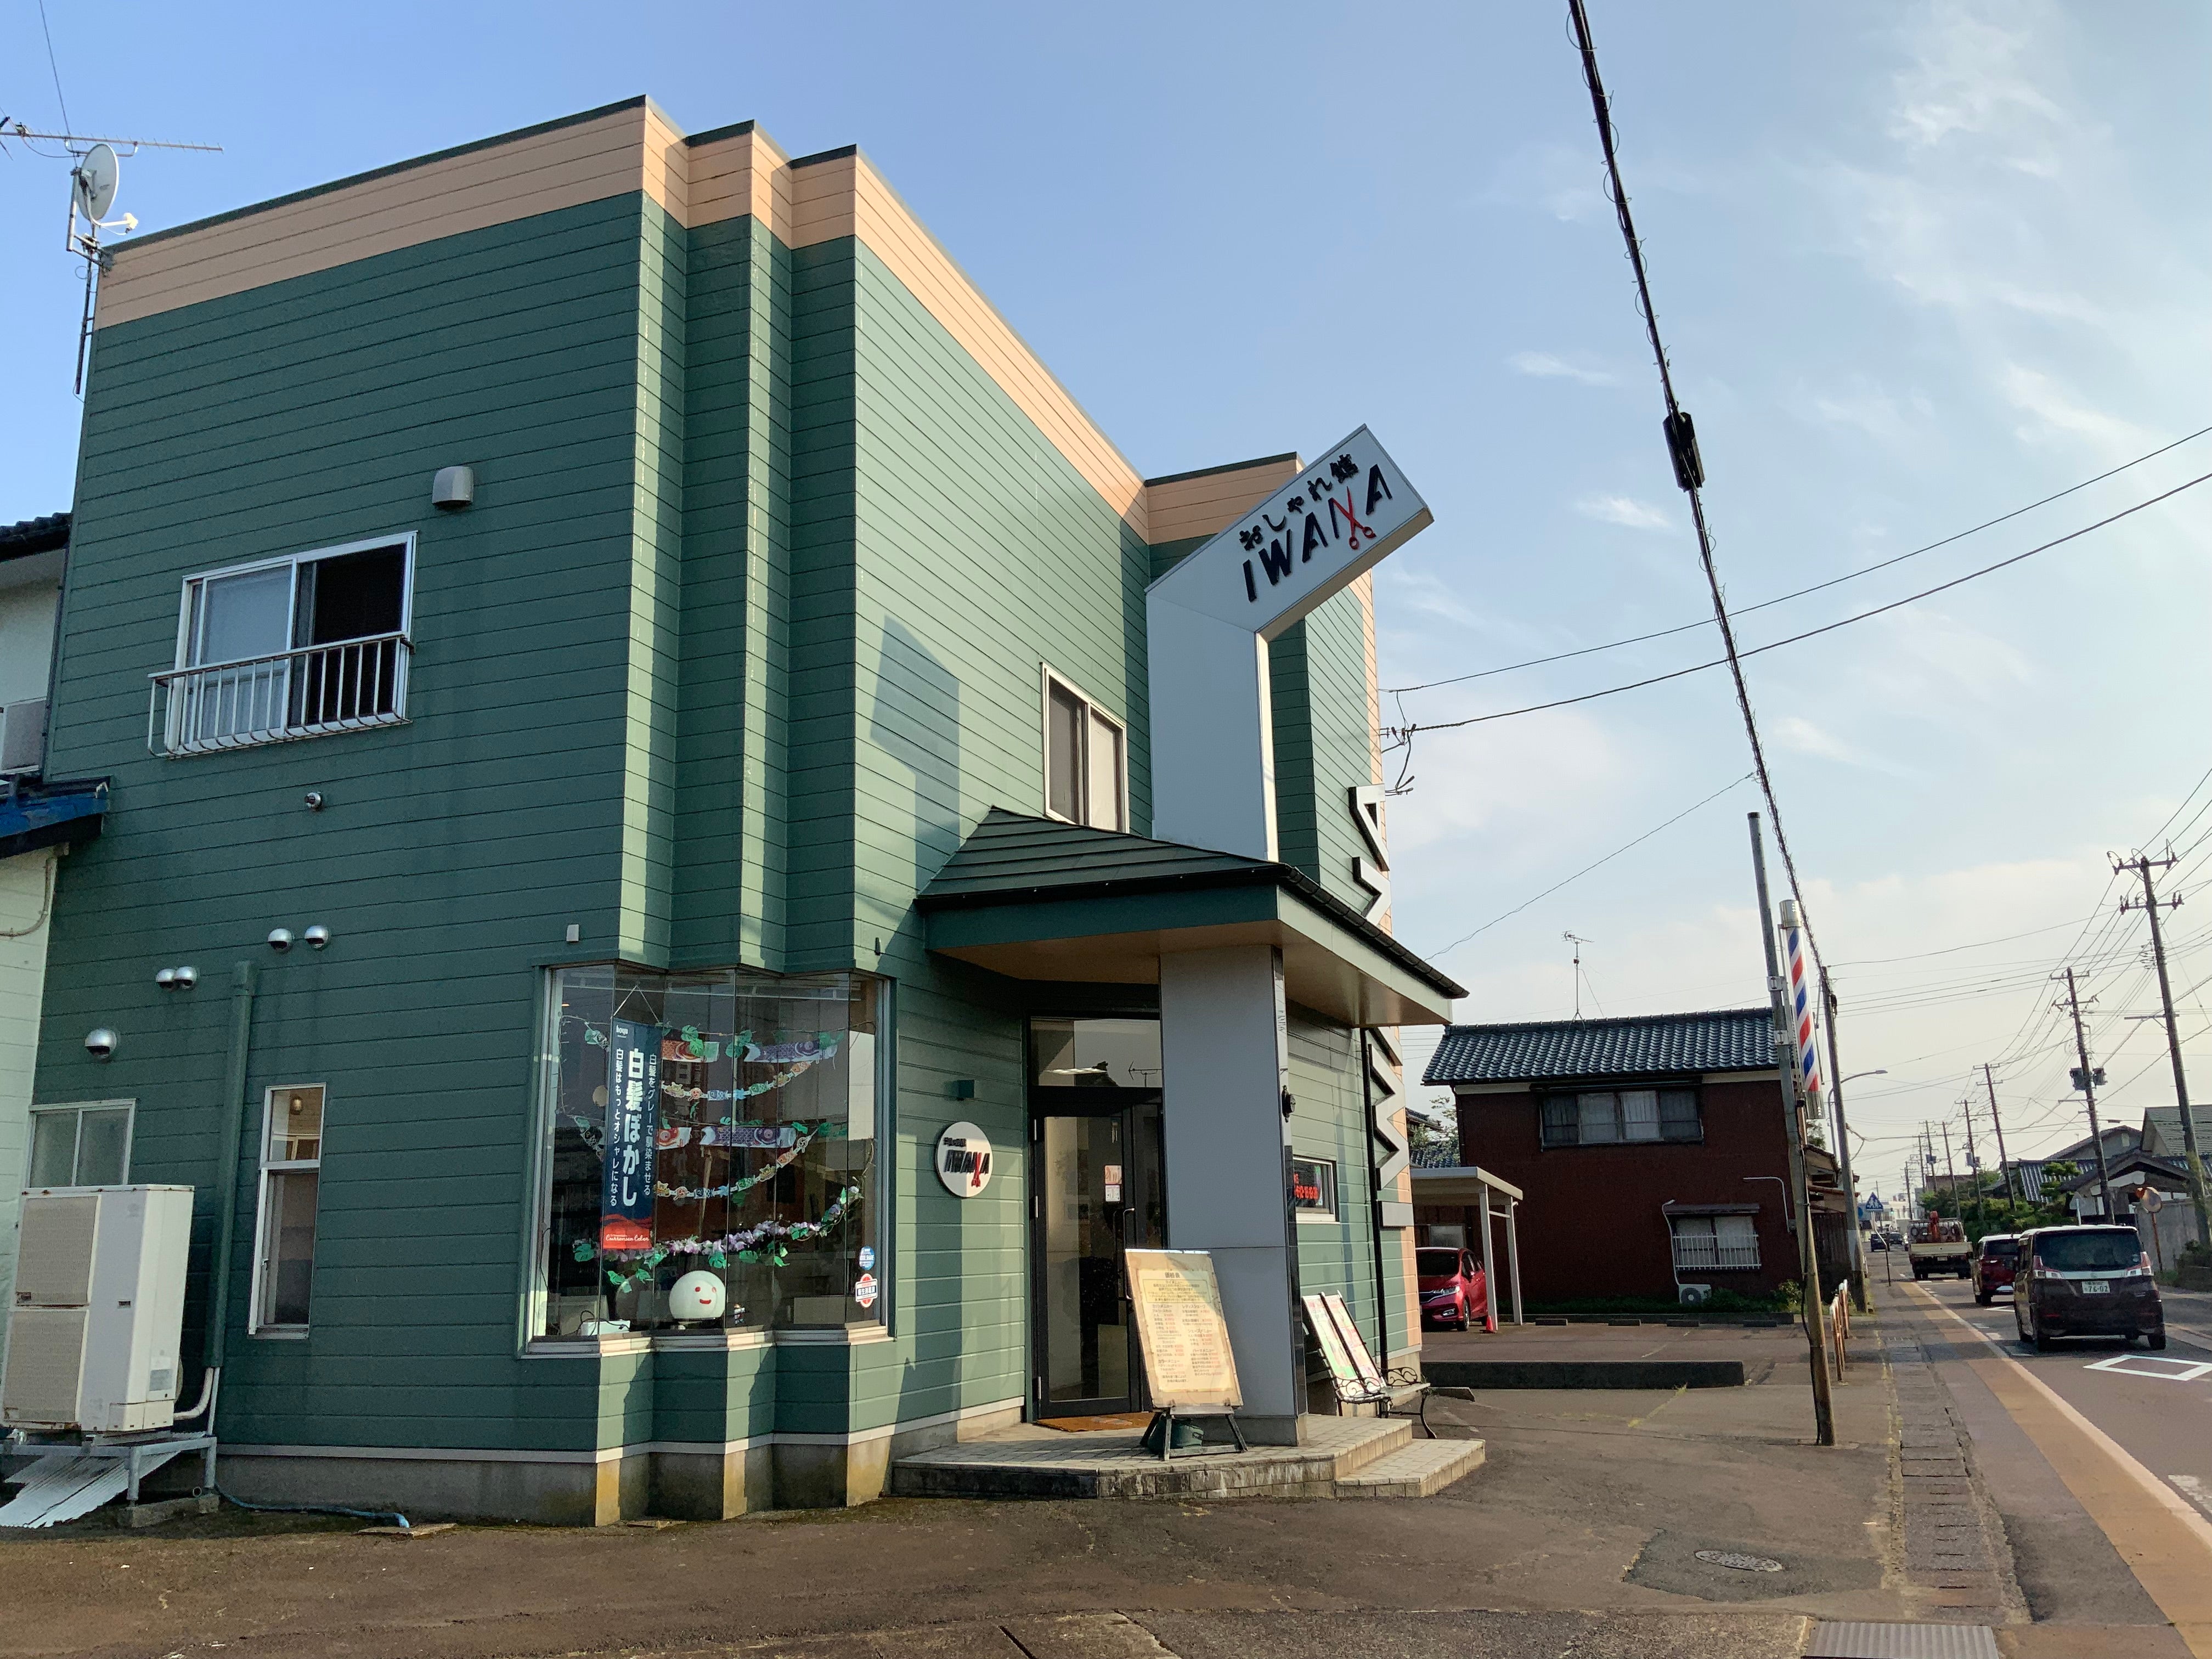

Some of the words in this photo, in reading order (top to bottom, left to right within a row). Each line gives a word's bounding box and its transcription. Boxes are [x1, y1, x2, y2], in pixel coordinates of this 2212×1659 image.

[1242, 464, 1393, 603] IWANA
[610, 1048, 624, 1207] 白髪はもっとオシャレになる
[623, 1048, 645, 1207] 白髪ぼかし
[644, 1053, 657, 1196] 白髪をグレーで馴染ませる
